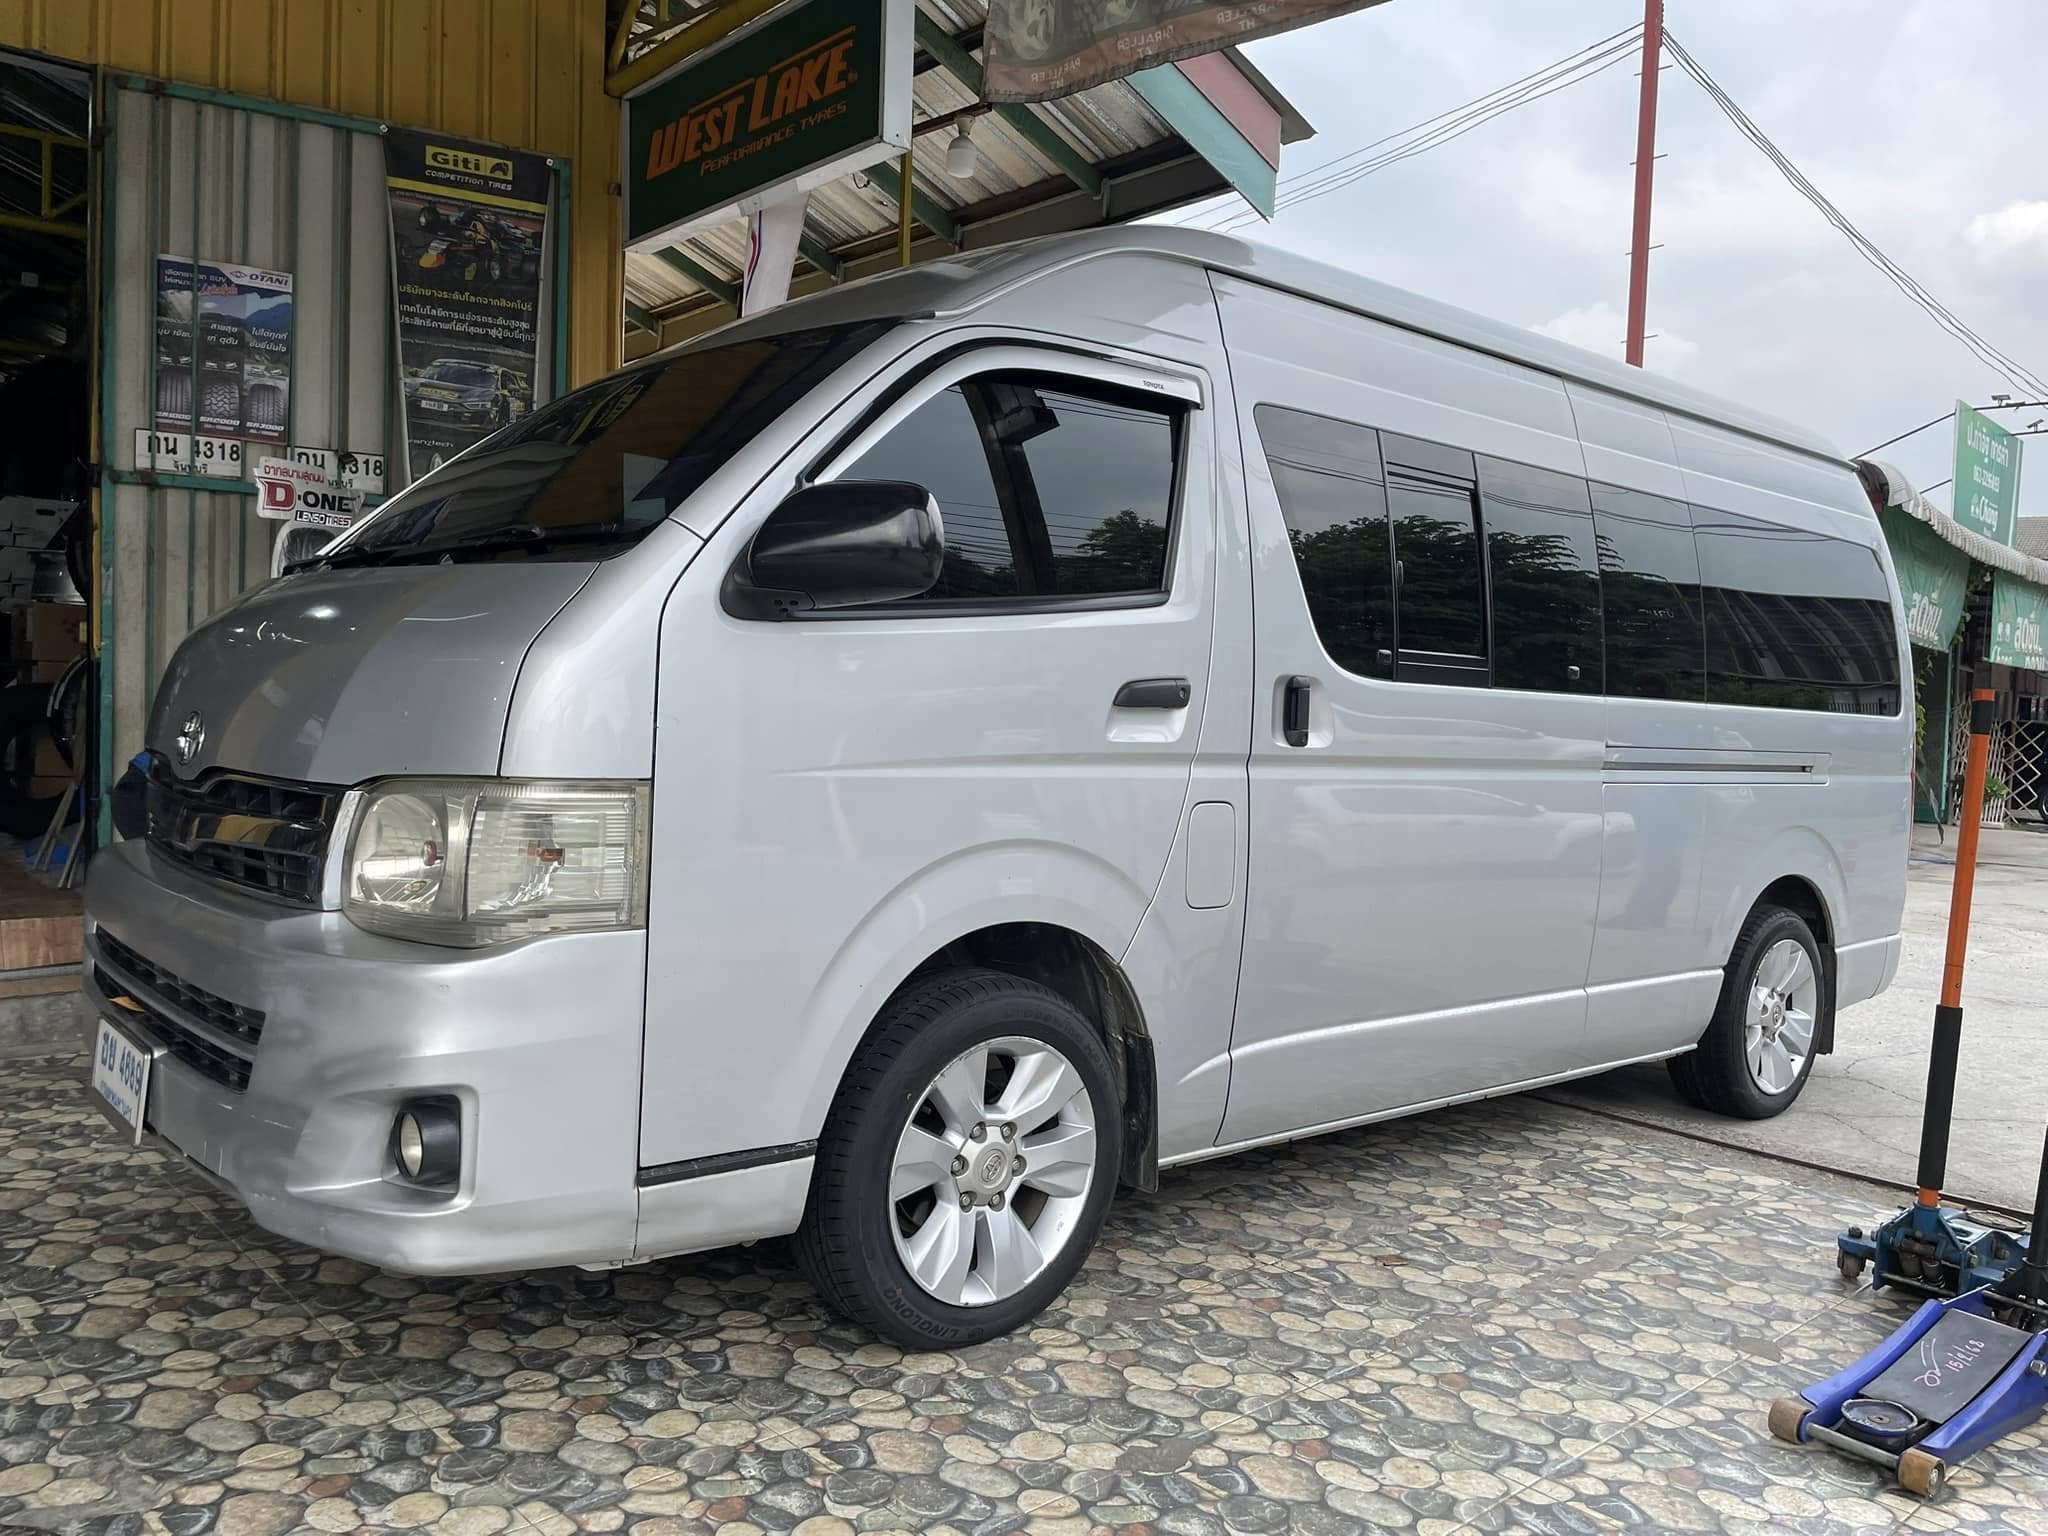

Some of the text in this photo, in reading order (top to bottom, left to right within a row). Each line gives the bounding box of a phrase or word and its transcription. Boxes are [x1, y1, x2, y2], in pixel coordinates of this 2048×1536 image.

[646, 94, 745, 181] WEST
[700, 101, 848, 177] PERFORMANCE TYRES
[431, 151, 481, 171] Giti
[488, 180, 513, 192] TIRES
[249, 272, 289, 286] OTANI
[1143, 380, 1165, 390] TOYOTA
